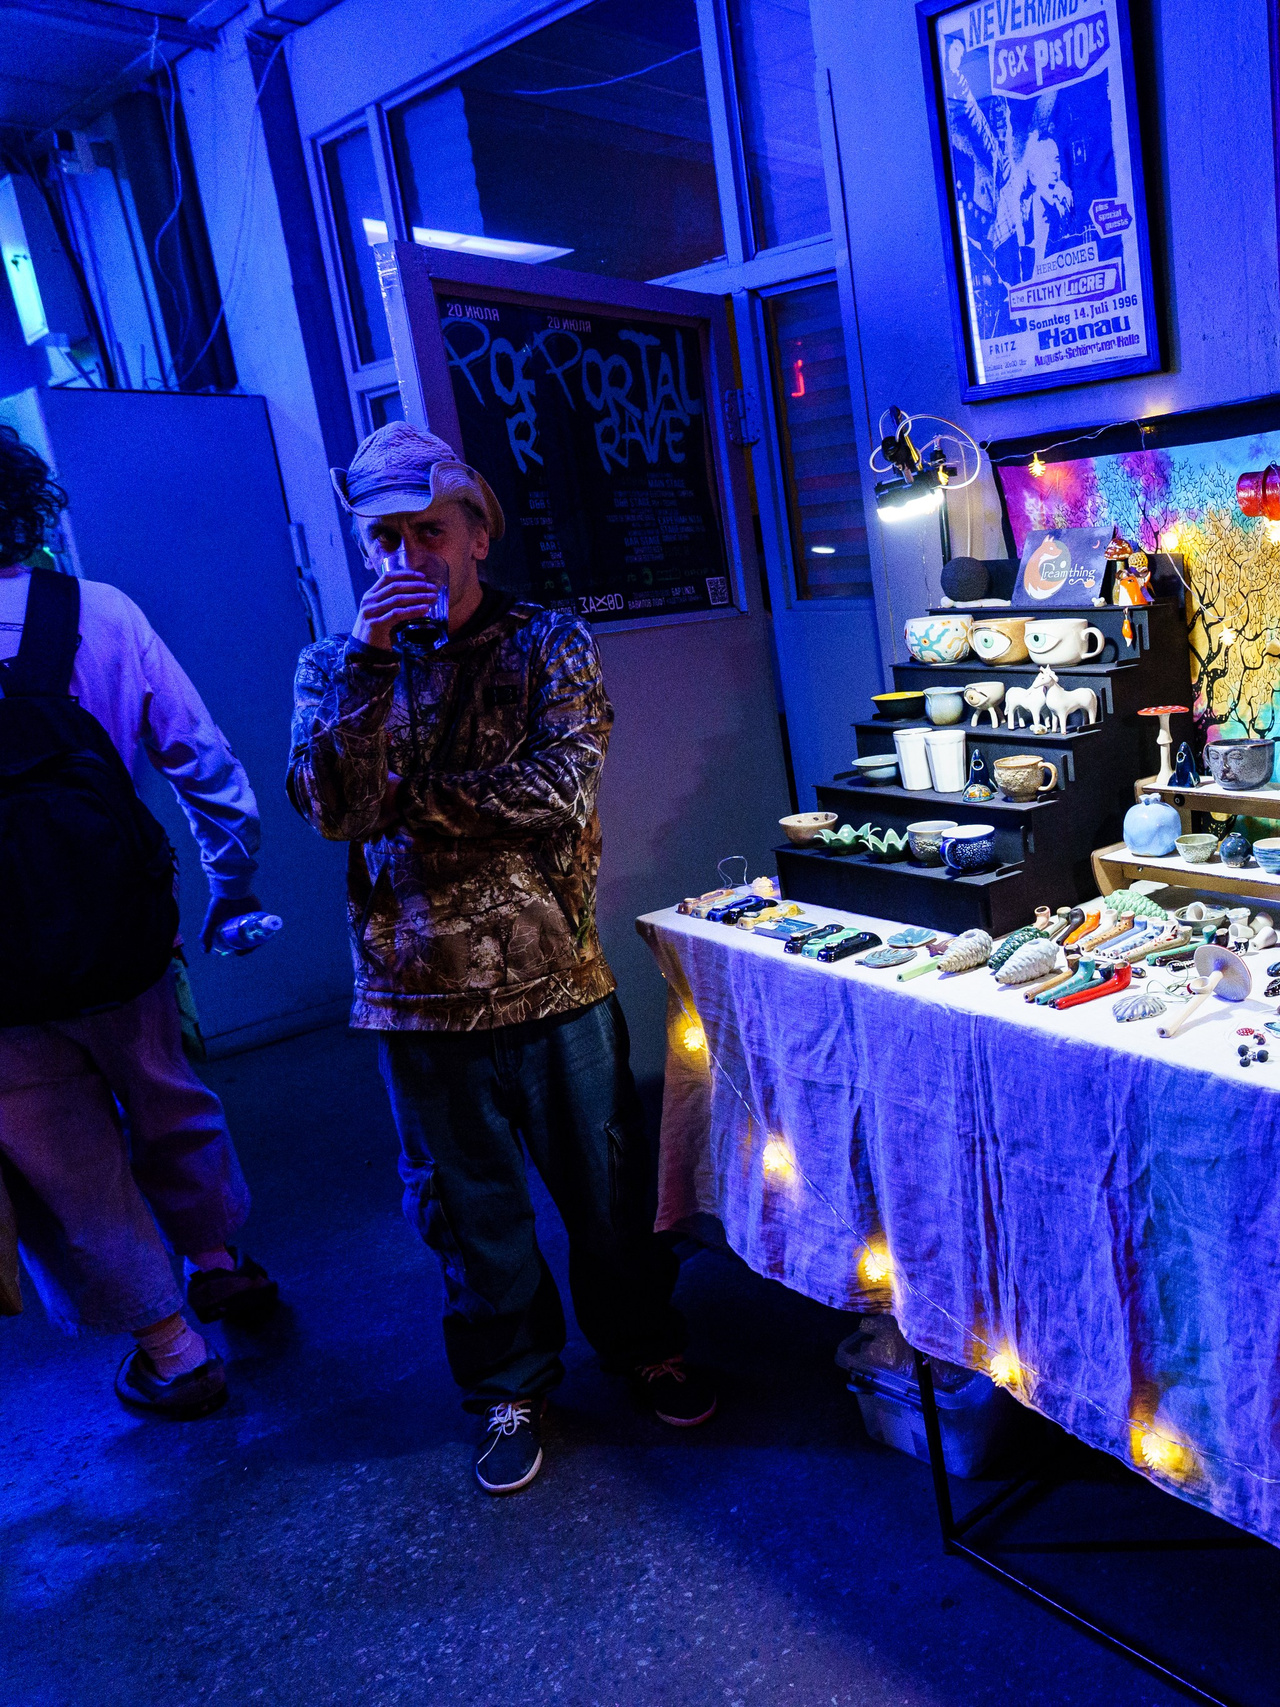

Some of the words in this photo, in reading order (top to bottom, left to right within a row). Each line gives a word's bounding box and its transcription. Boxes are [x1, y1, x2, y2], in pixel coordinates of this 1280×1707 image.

[1095, 202, 1109, 212] plus
[1098, 209, 1122, 222] special
[1104, 218, 1129, 231] guests
[1036, 260, 1057, 276] HERE
[1056, 247, 1095, 269] COMES
[1012, 294, 1025, 305] the
[1026, 284, 1062, 304] FILTHY
[446, 302, 463, 318] 20
[464, 305, 500, 322] ИЮЛЯ
[1029, 313, 1071, 331] Sonntag
[1113, 294, 1138, 311] 1996
[546, 315, 561, 330] 20
[562, 317, 592, 333] ИЮЛЯ
[1038, 315, 1131, 351] Hanau
[989, 340, 1017, 356] FRITZ
[532, 328, 702, 422] PORTAL
[594, 410, 691, 475] RAVE
